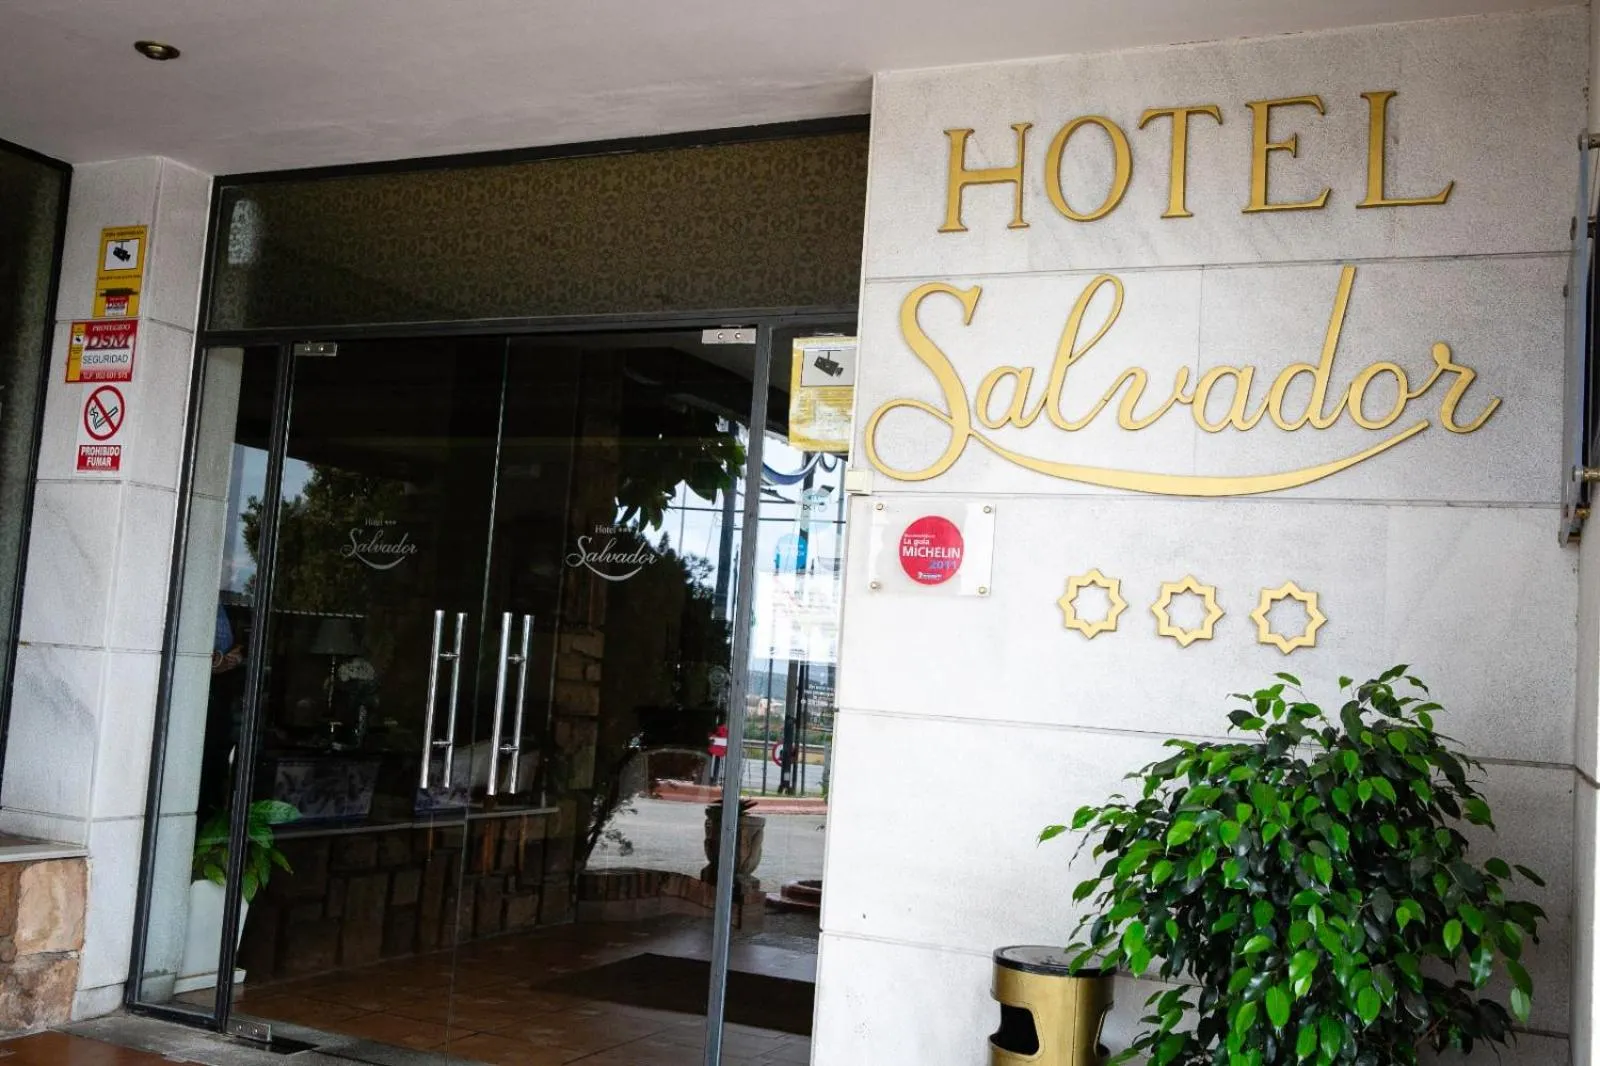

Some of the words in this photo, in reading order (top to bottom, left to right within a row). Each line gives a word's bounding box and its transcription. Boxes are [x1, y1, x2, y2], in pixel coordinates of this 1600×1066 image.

[937, 90, 1455, 233] HOTEL
[85, 333, 130, 350] DSM
[82, 353, 129, 365] SEGURIDAD
[864, 266, 1503, 496] Salvador
[80, 446, 120, 456] PROHIBIDO
[86, 456, 112, 467] FUMAR
[595, 525, 616, 534] Hotel
[340, 527, 418, 569] Salvador
[903, 546, 961, 558] MICHELIN
[566, 535, 658, 581] Salvador
